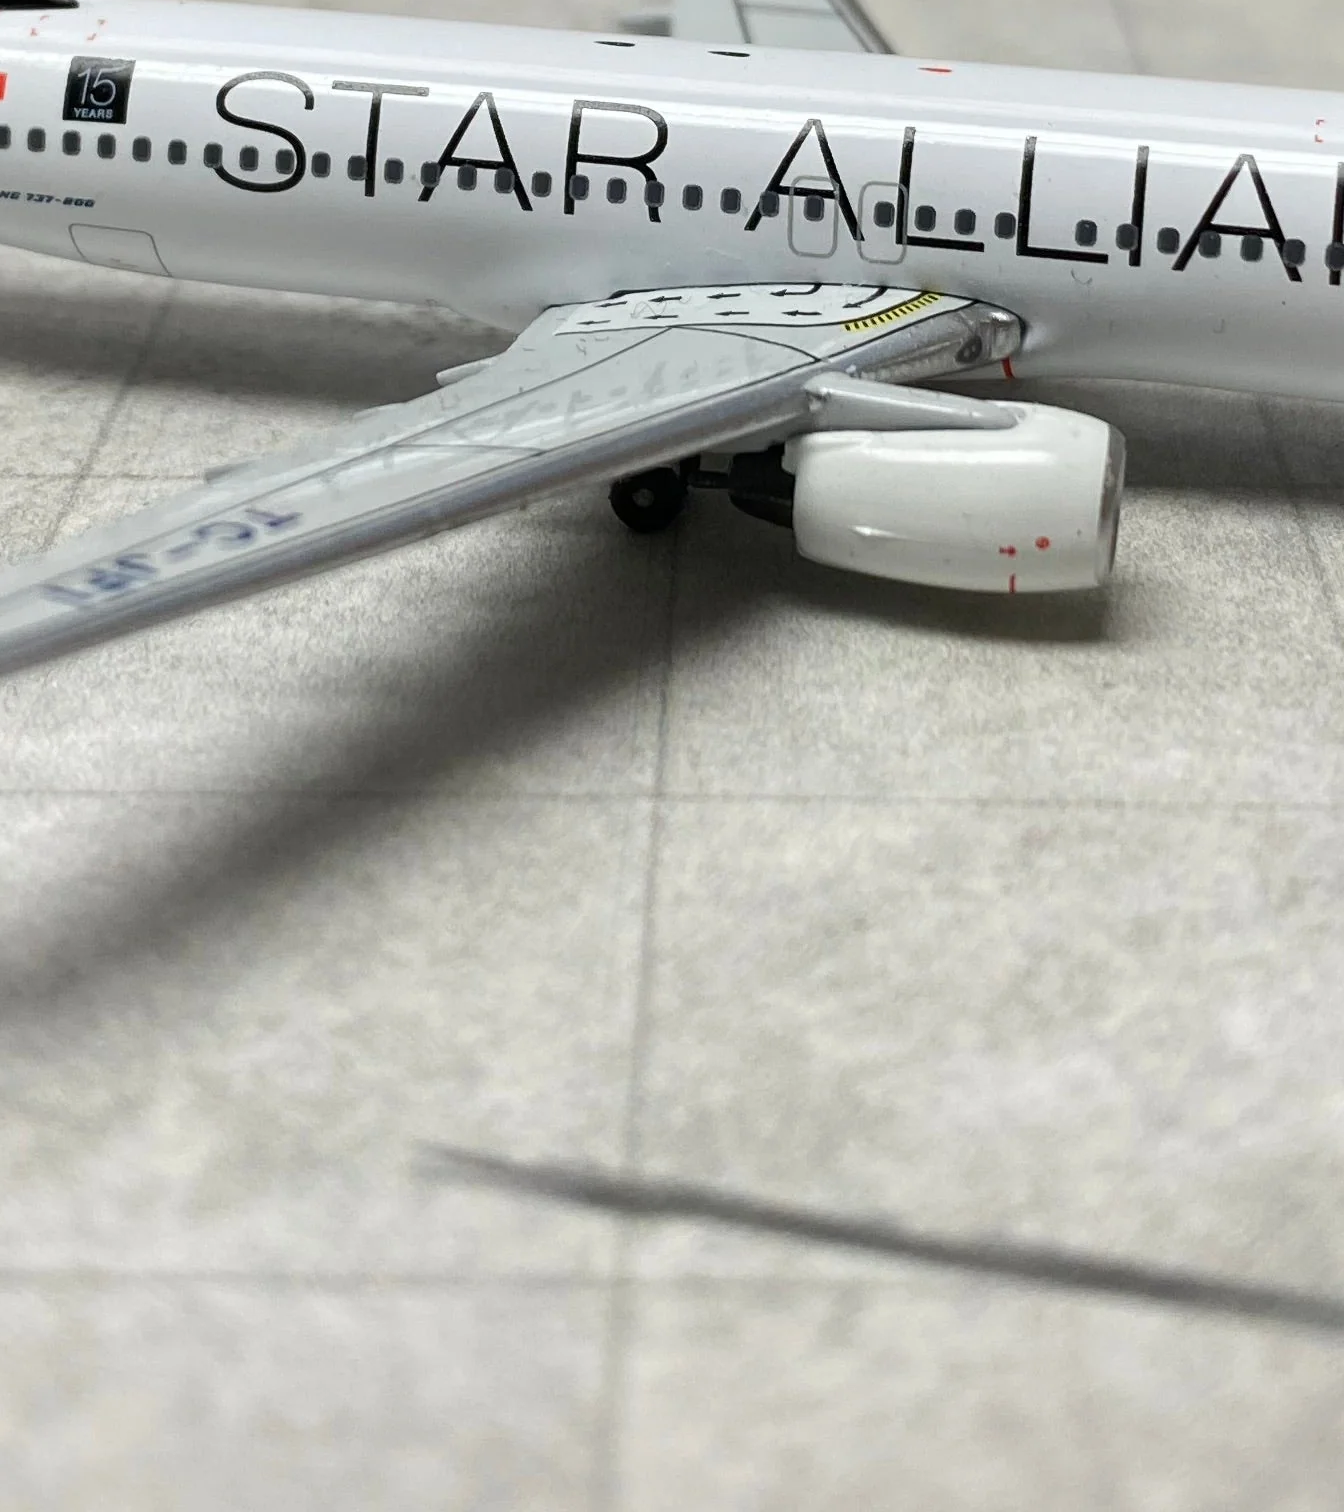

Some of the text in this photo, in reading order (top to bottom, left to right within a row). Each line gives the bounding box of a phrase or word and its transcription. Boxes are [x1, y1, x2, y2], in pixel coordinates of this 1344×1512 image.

[76, 66, 127, 106] 15
[73, 107, 114, 120] YEARS
[215, 71, 668, 223] STAR
[26, 192, 96, 208] 737-800
